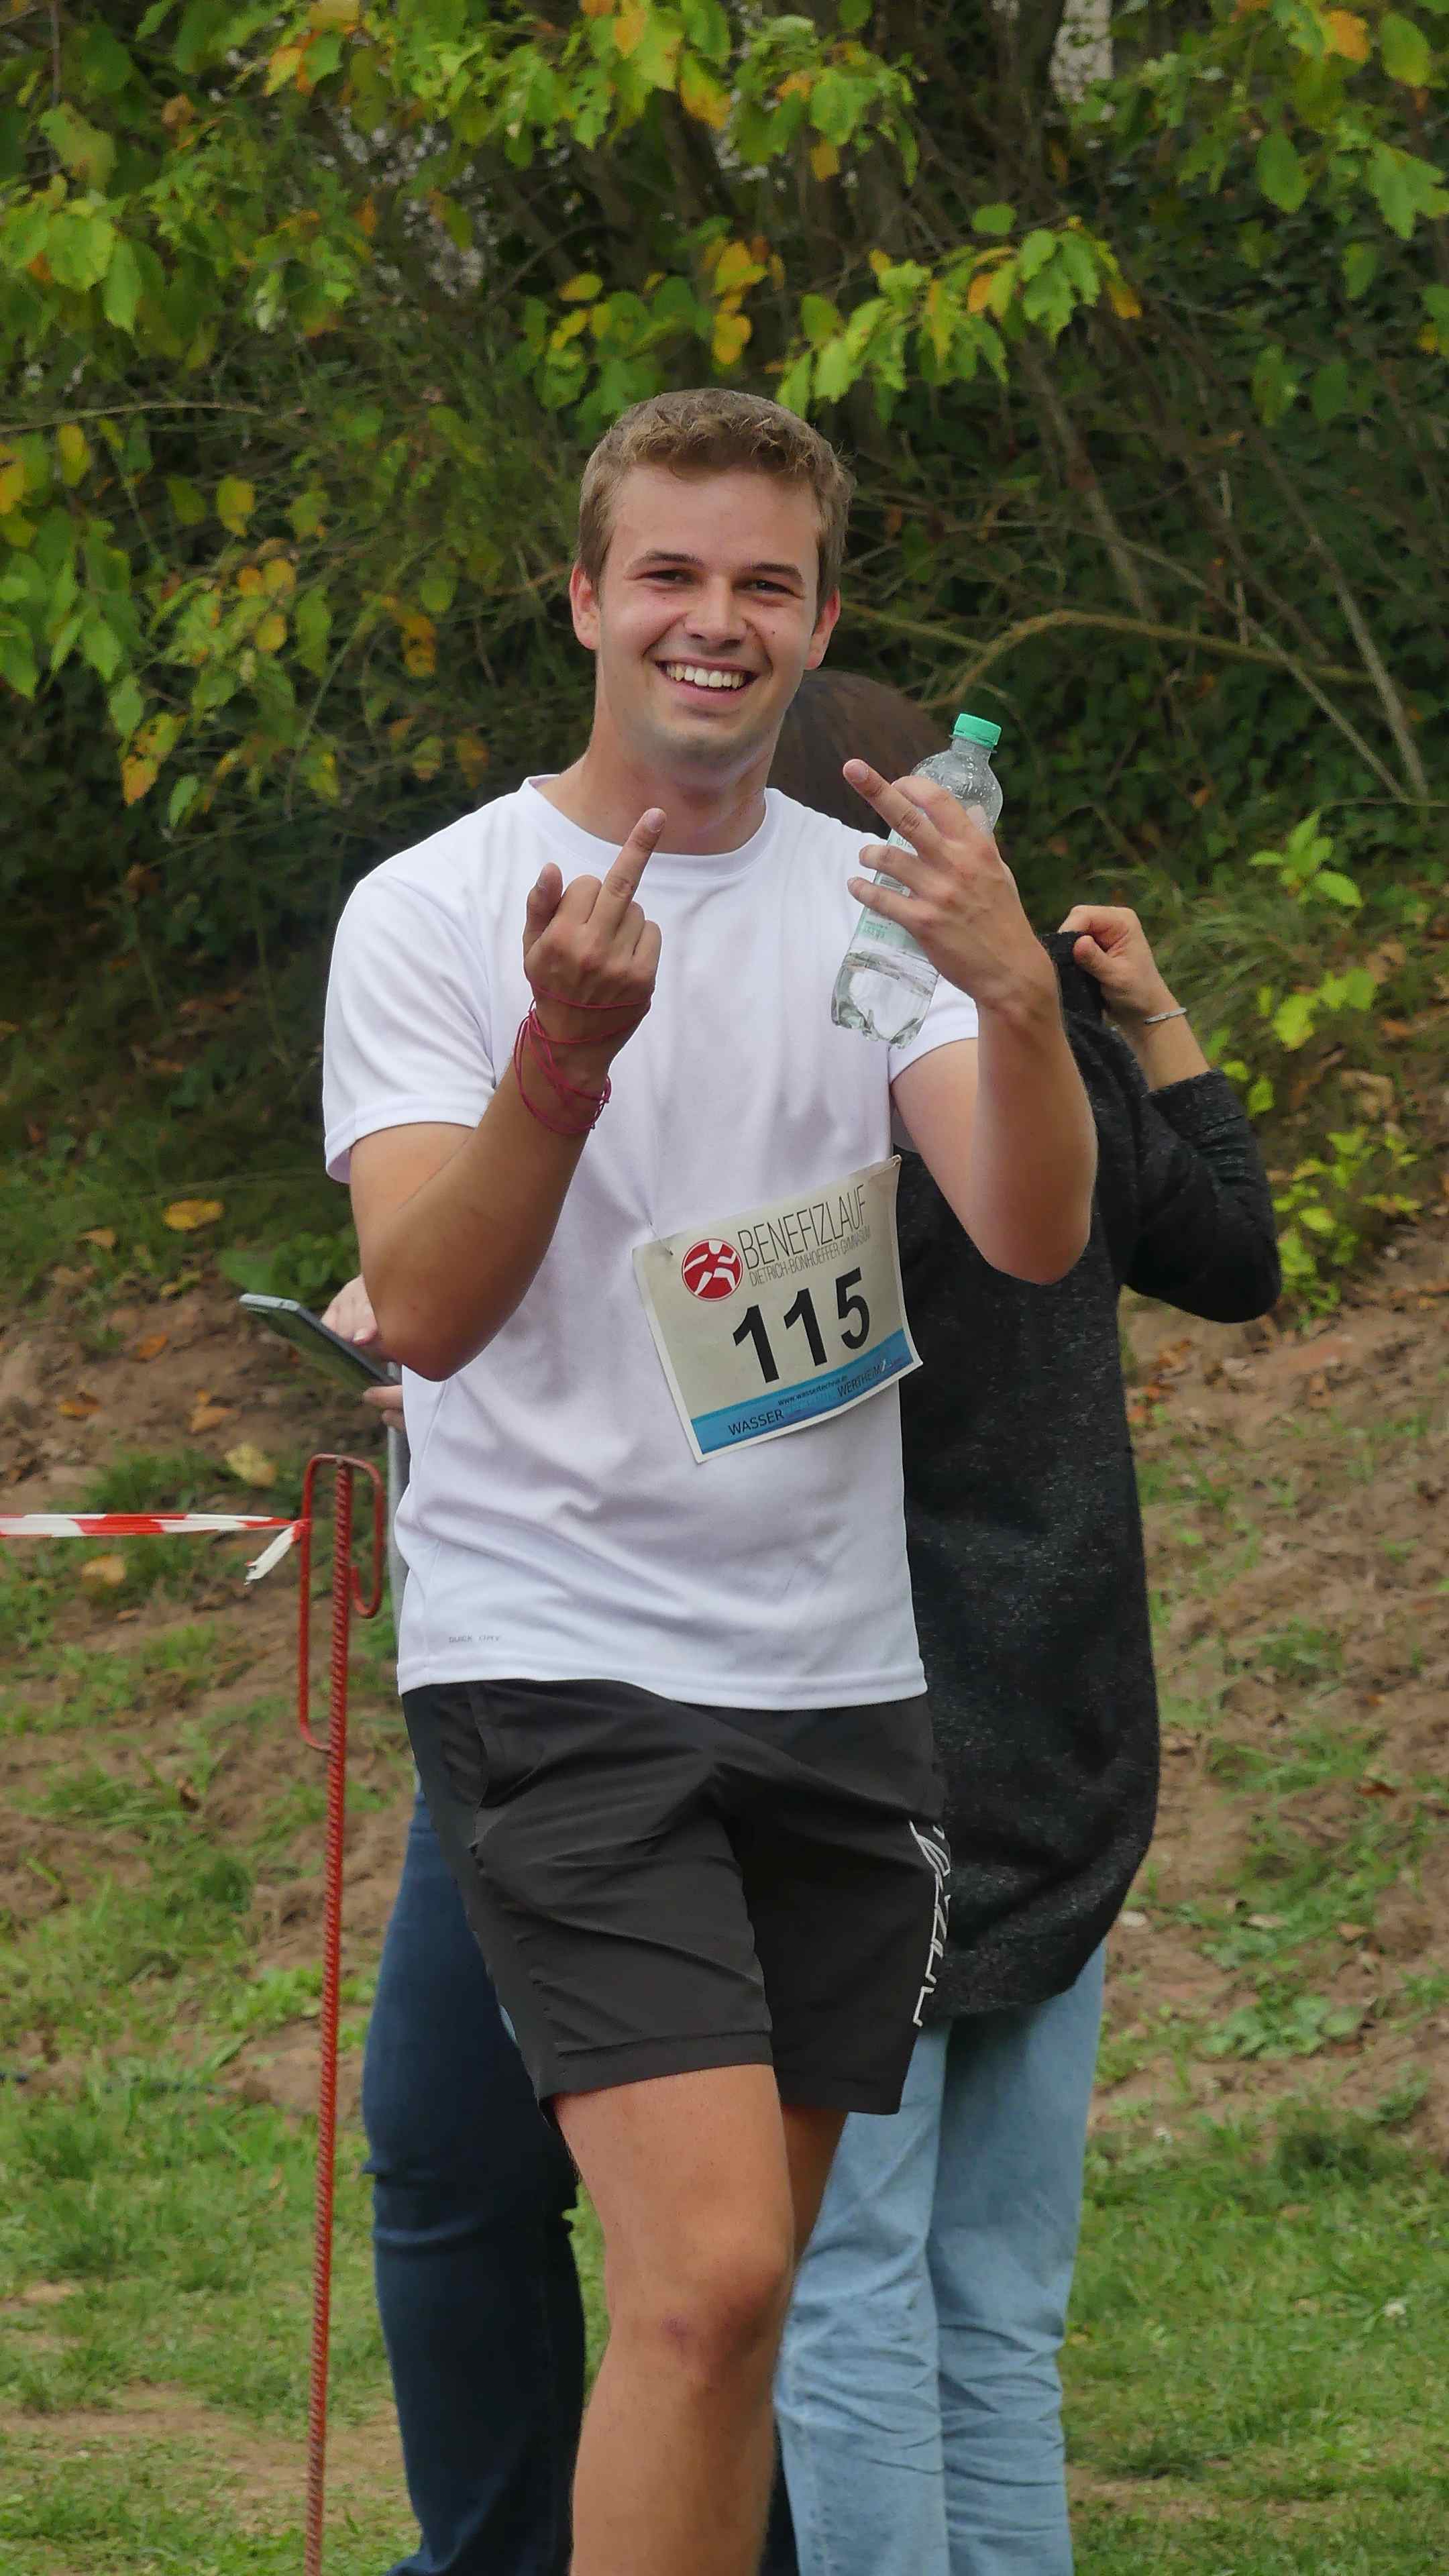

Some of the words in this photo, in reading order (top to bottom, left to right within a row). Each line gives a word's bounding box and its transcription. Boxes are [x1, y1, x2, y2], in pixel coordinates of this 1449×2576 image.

[738, 1184, 865, 1269] BENEFIZLAUF
[733, 1267, 870, 1384] 115
[729, 1409, 784, 1436] WASSER
